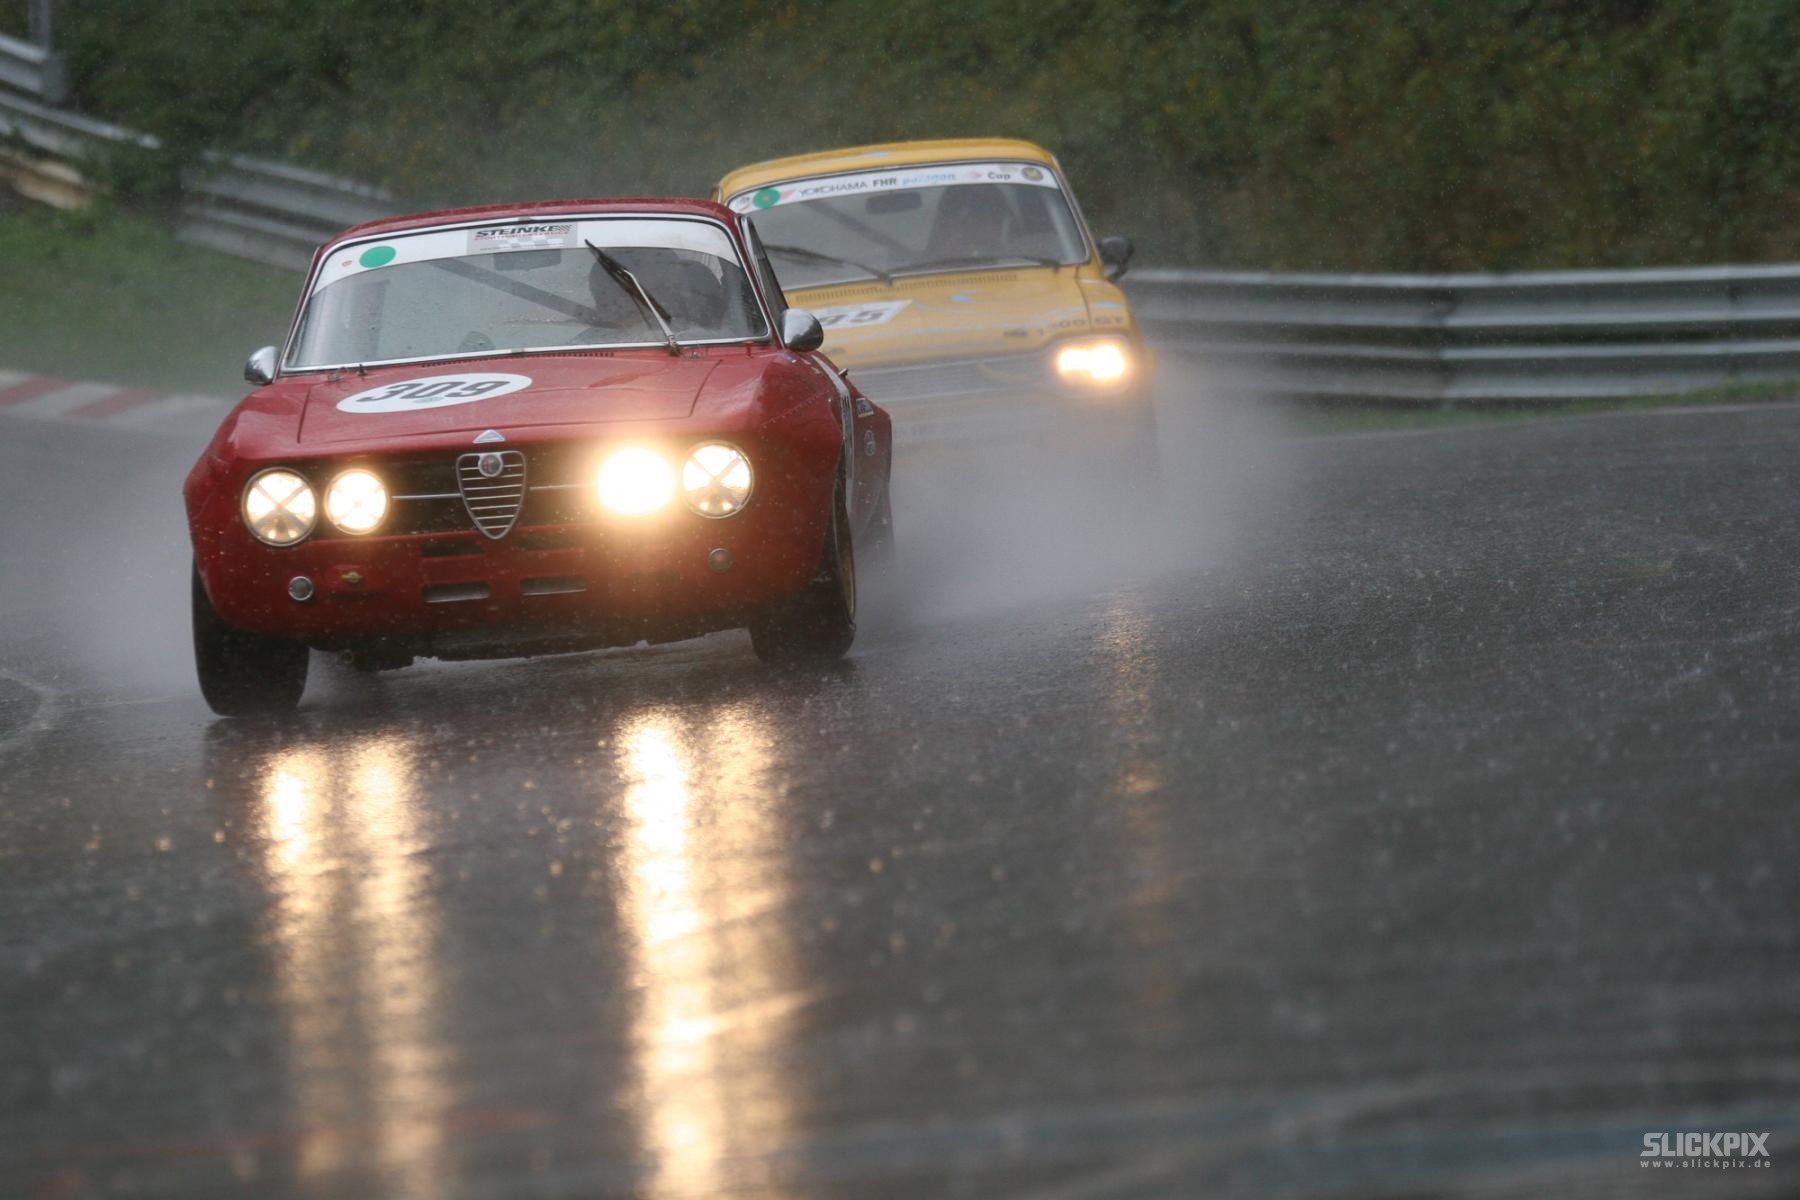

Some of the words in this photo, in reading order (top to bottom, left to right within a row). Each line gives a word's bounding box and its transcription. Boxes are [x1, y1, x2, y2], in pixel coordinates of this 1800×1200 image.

[799, 181, 868, 196] YOKOHAMA
[873, 177, 897, 188] FHR
[987, 170, 1011, 181] Cup
[475, 225, 560, 238] STEINKE
[355, 380, 512, 403] 309
